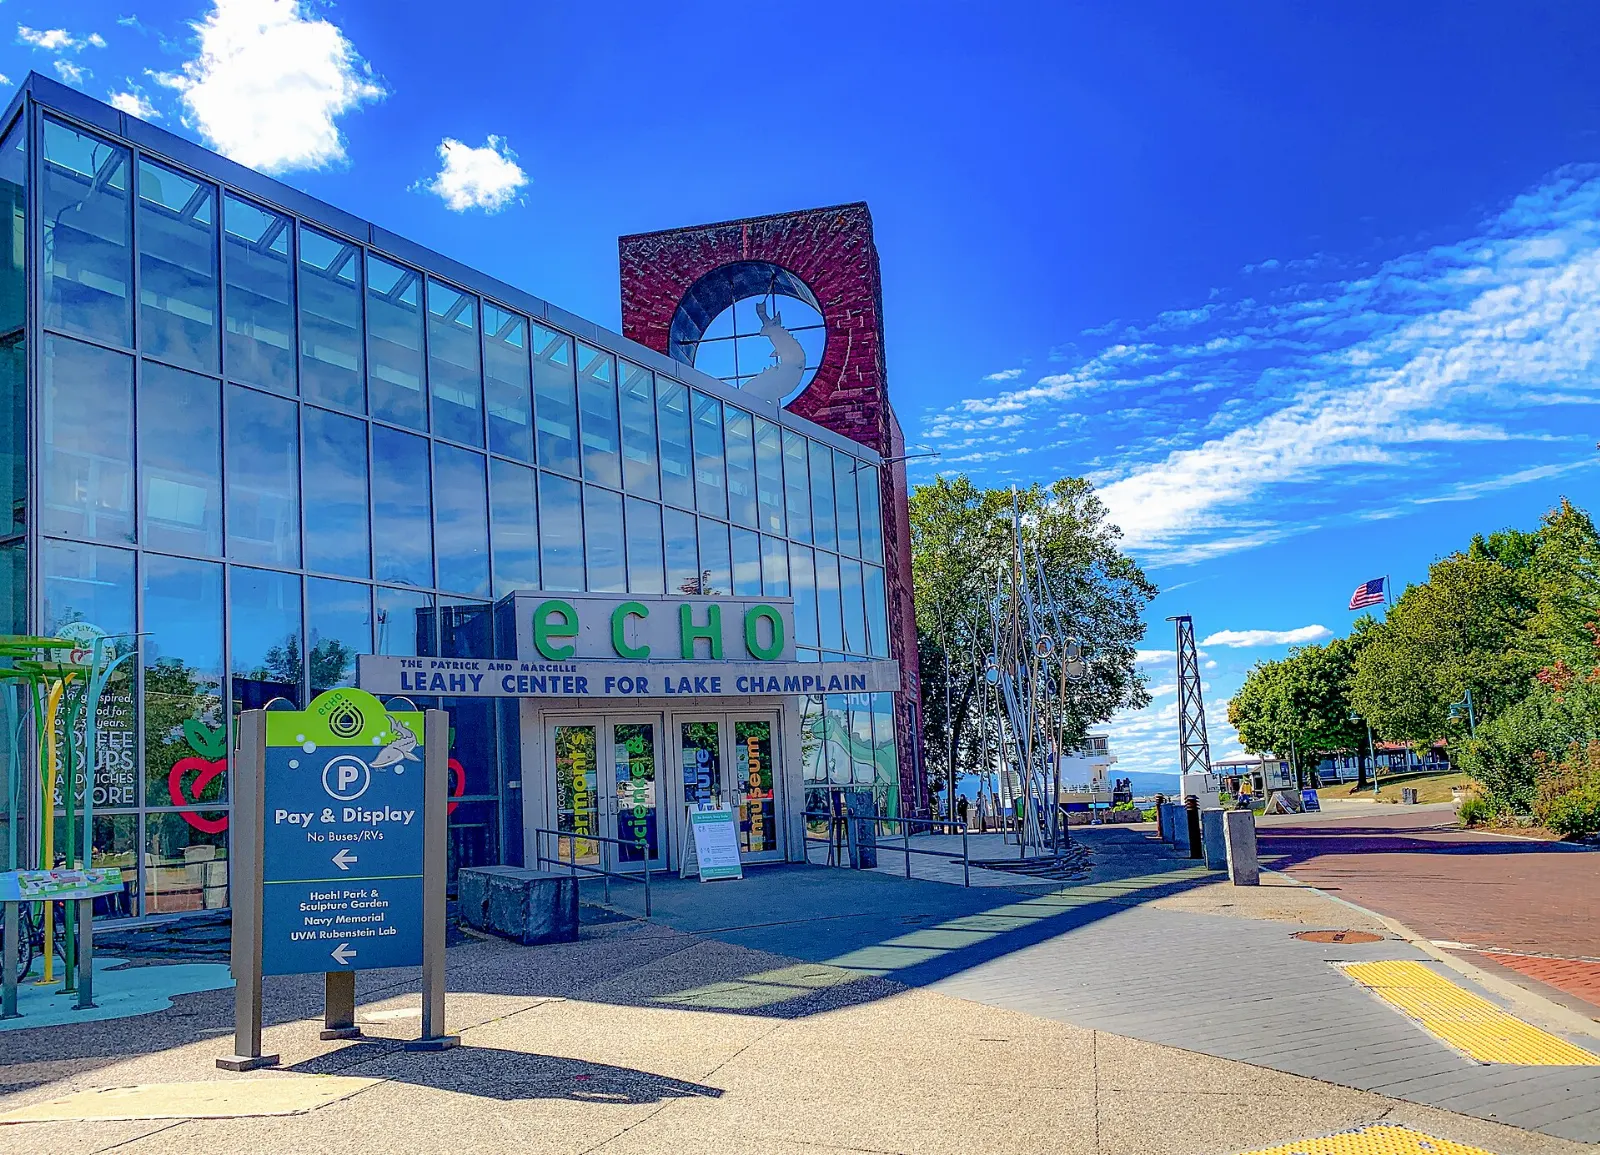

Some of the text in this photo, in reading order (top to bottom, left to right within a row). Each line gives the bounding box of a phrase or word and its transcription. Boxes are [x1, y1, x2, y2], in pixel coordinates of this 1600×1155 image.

[400, 659, 577, 673] THE PATRICK AND MARCELLE
[400, 671, 866, 694] LEAHY CENTER FOR LAKE CHAMPLAIN
[111, 704, 127, 718] for
[97, 719, 128, 729] years.
[625, 734, 645, 754] &
[747, 736, 764, 836] museum
[275, 805, 415, 828] Pay & Display
[307, 830, 384, 843] No Buses/RVs
[310, 889, 379, 901] Hoehl Park &
[300, 898, 389, 912] Sculpture Garden
[304, 912, 384, 927] Navy Memorial
[291, 926, 397, 940] UVM Rubenstein Lab
